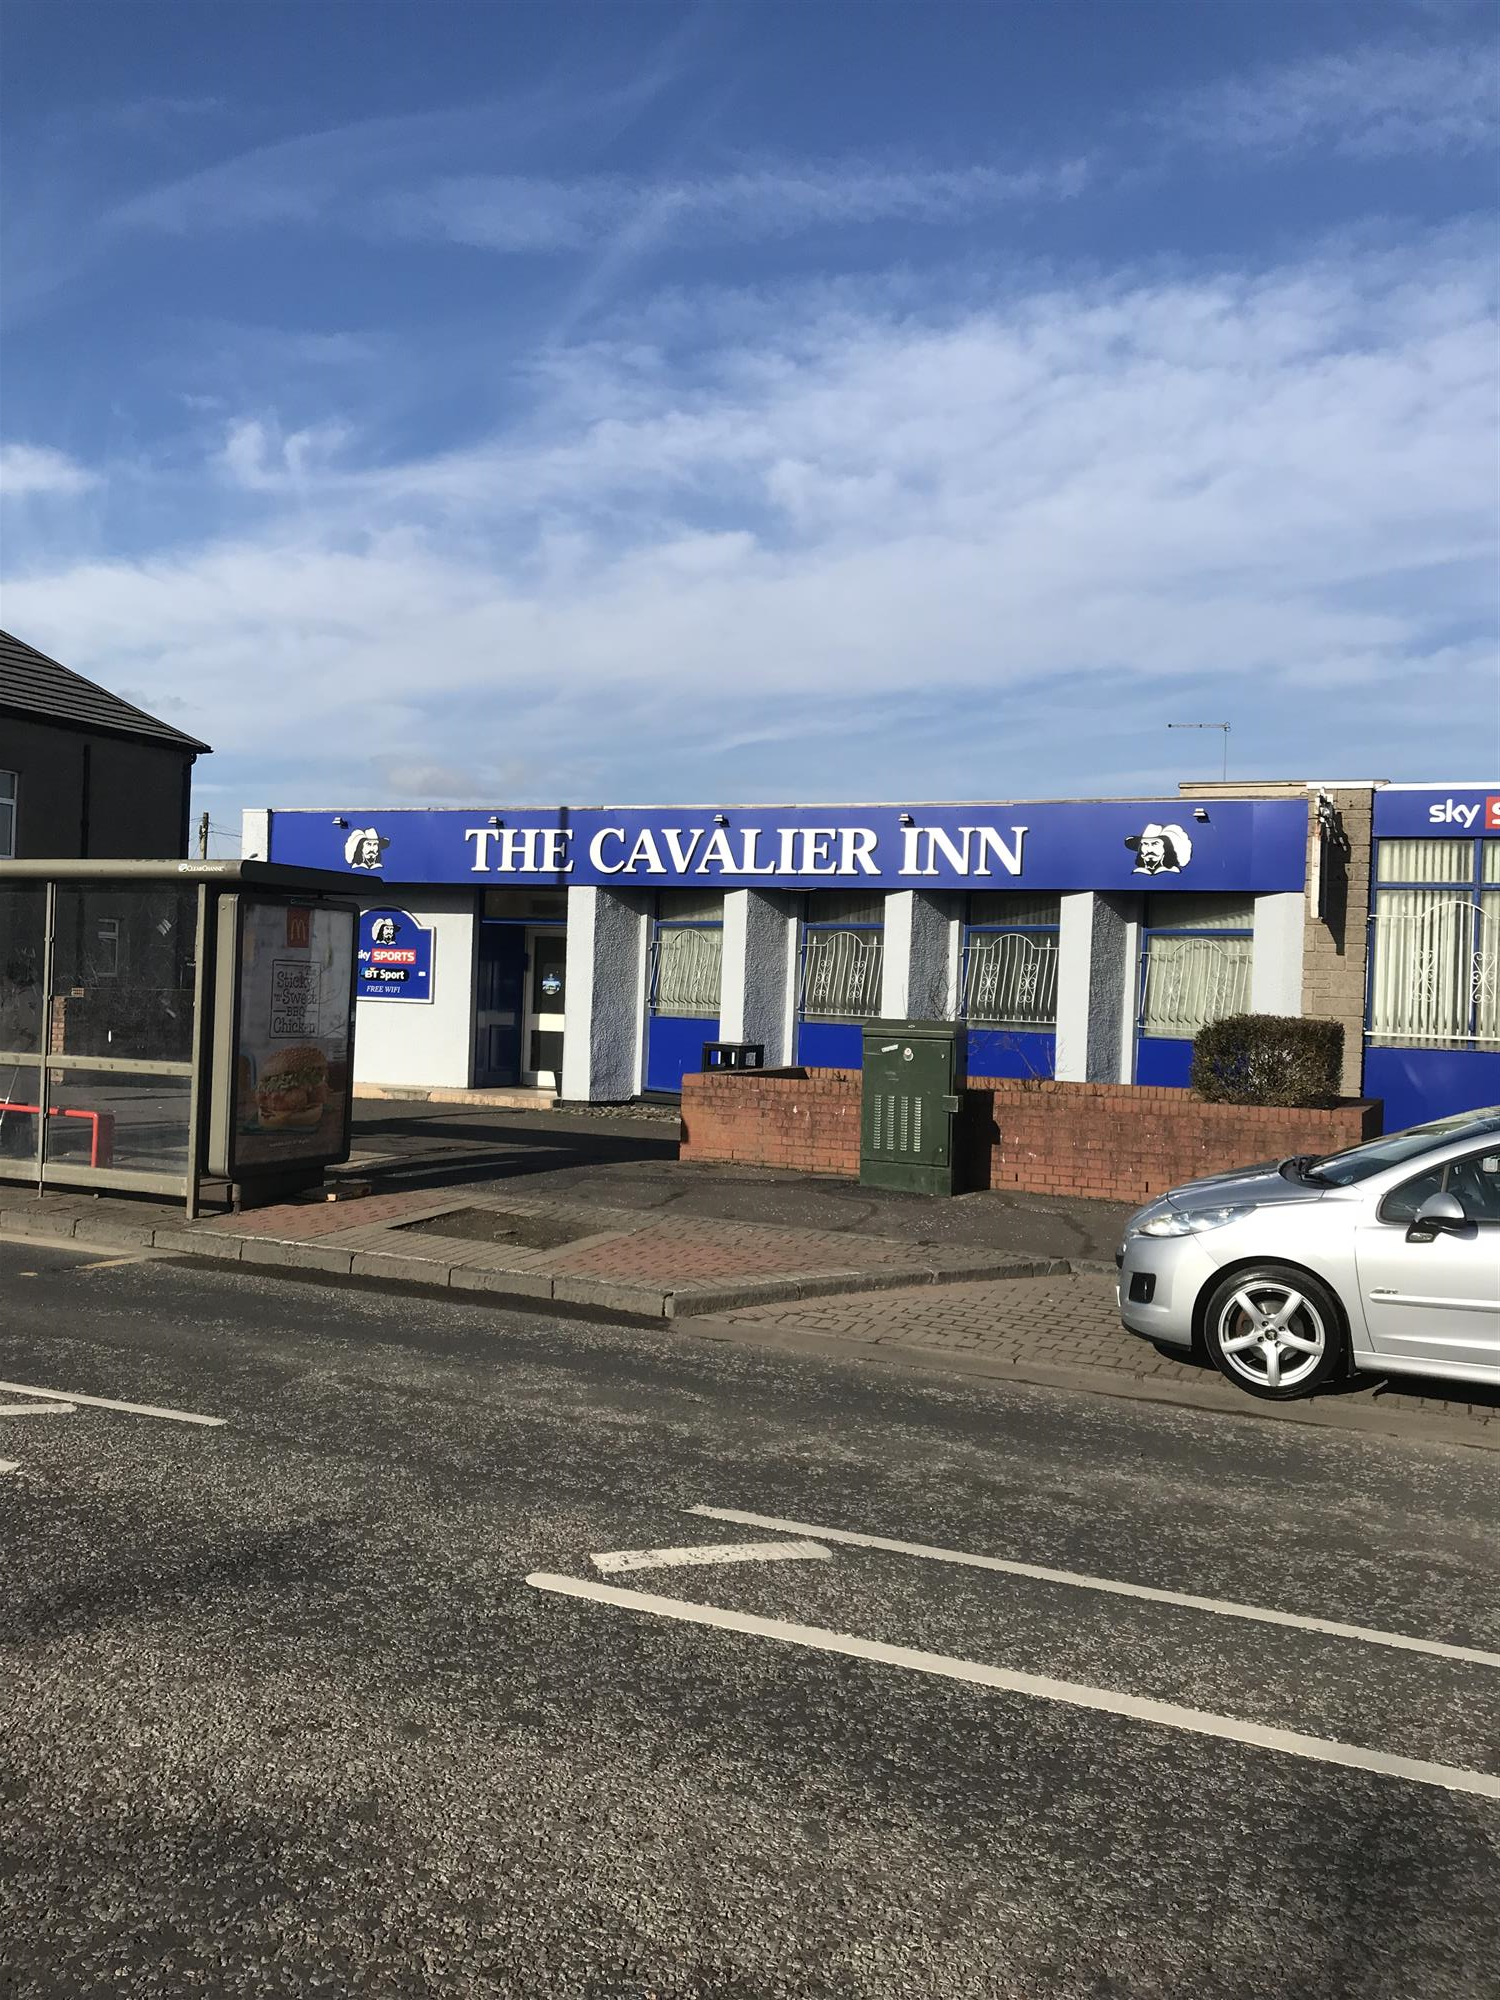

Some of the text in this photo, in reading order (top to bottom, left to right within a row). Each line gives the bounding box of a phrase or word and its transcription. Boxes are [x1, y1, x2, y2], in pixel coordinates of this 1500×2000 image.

[1429, 799, 1481, 828] sky
[465, 827, 1029, 875] THE CAVALIER INN
[373, 951, 415, 962] SPORTS
[365, 969, 405, 981] BT Sport
[366, 985, 401, 994] FREE WIFI
